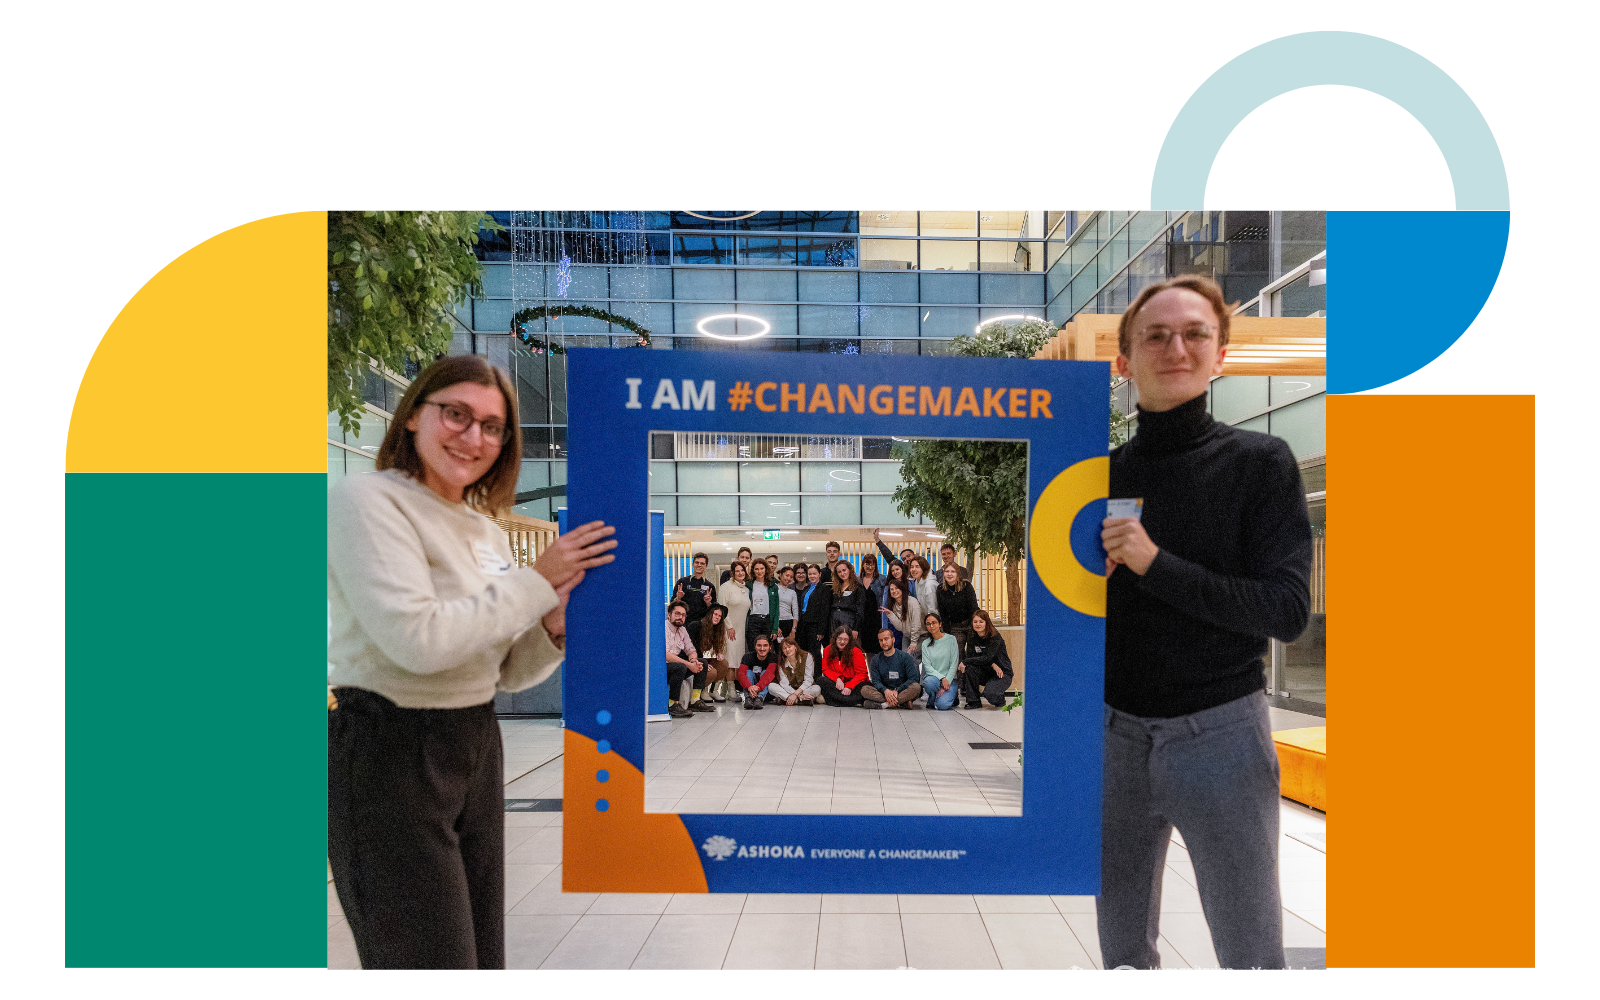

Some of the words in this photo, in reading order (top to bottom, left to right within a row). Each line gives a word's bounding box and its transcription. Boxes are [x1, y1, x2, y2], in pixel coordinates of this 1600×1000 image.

[625, 378, 643, 409] I
[651, 378, 716, 411] AM
[727, 381, 1054, 418] #CHANGEMAKER
[737, 845, 805, 859] ASHOKA
[810, 848, 866, 859] EVERYONE
[868, 849, 877, 859] A
